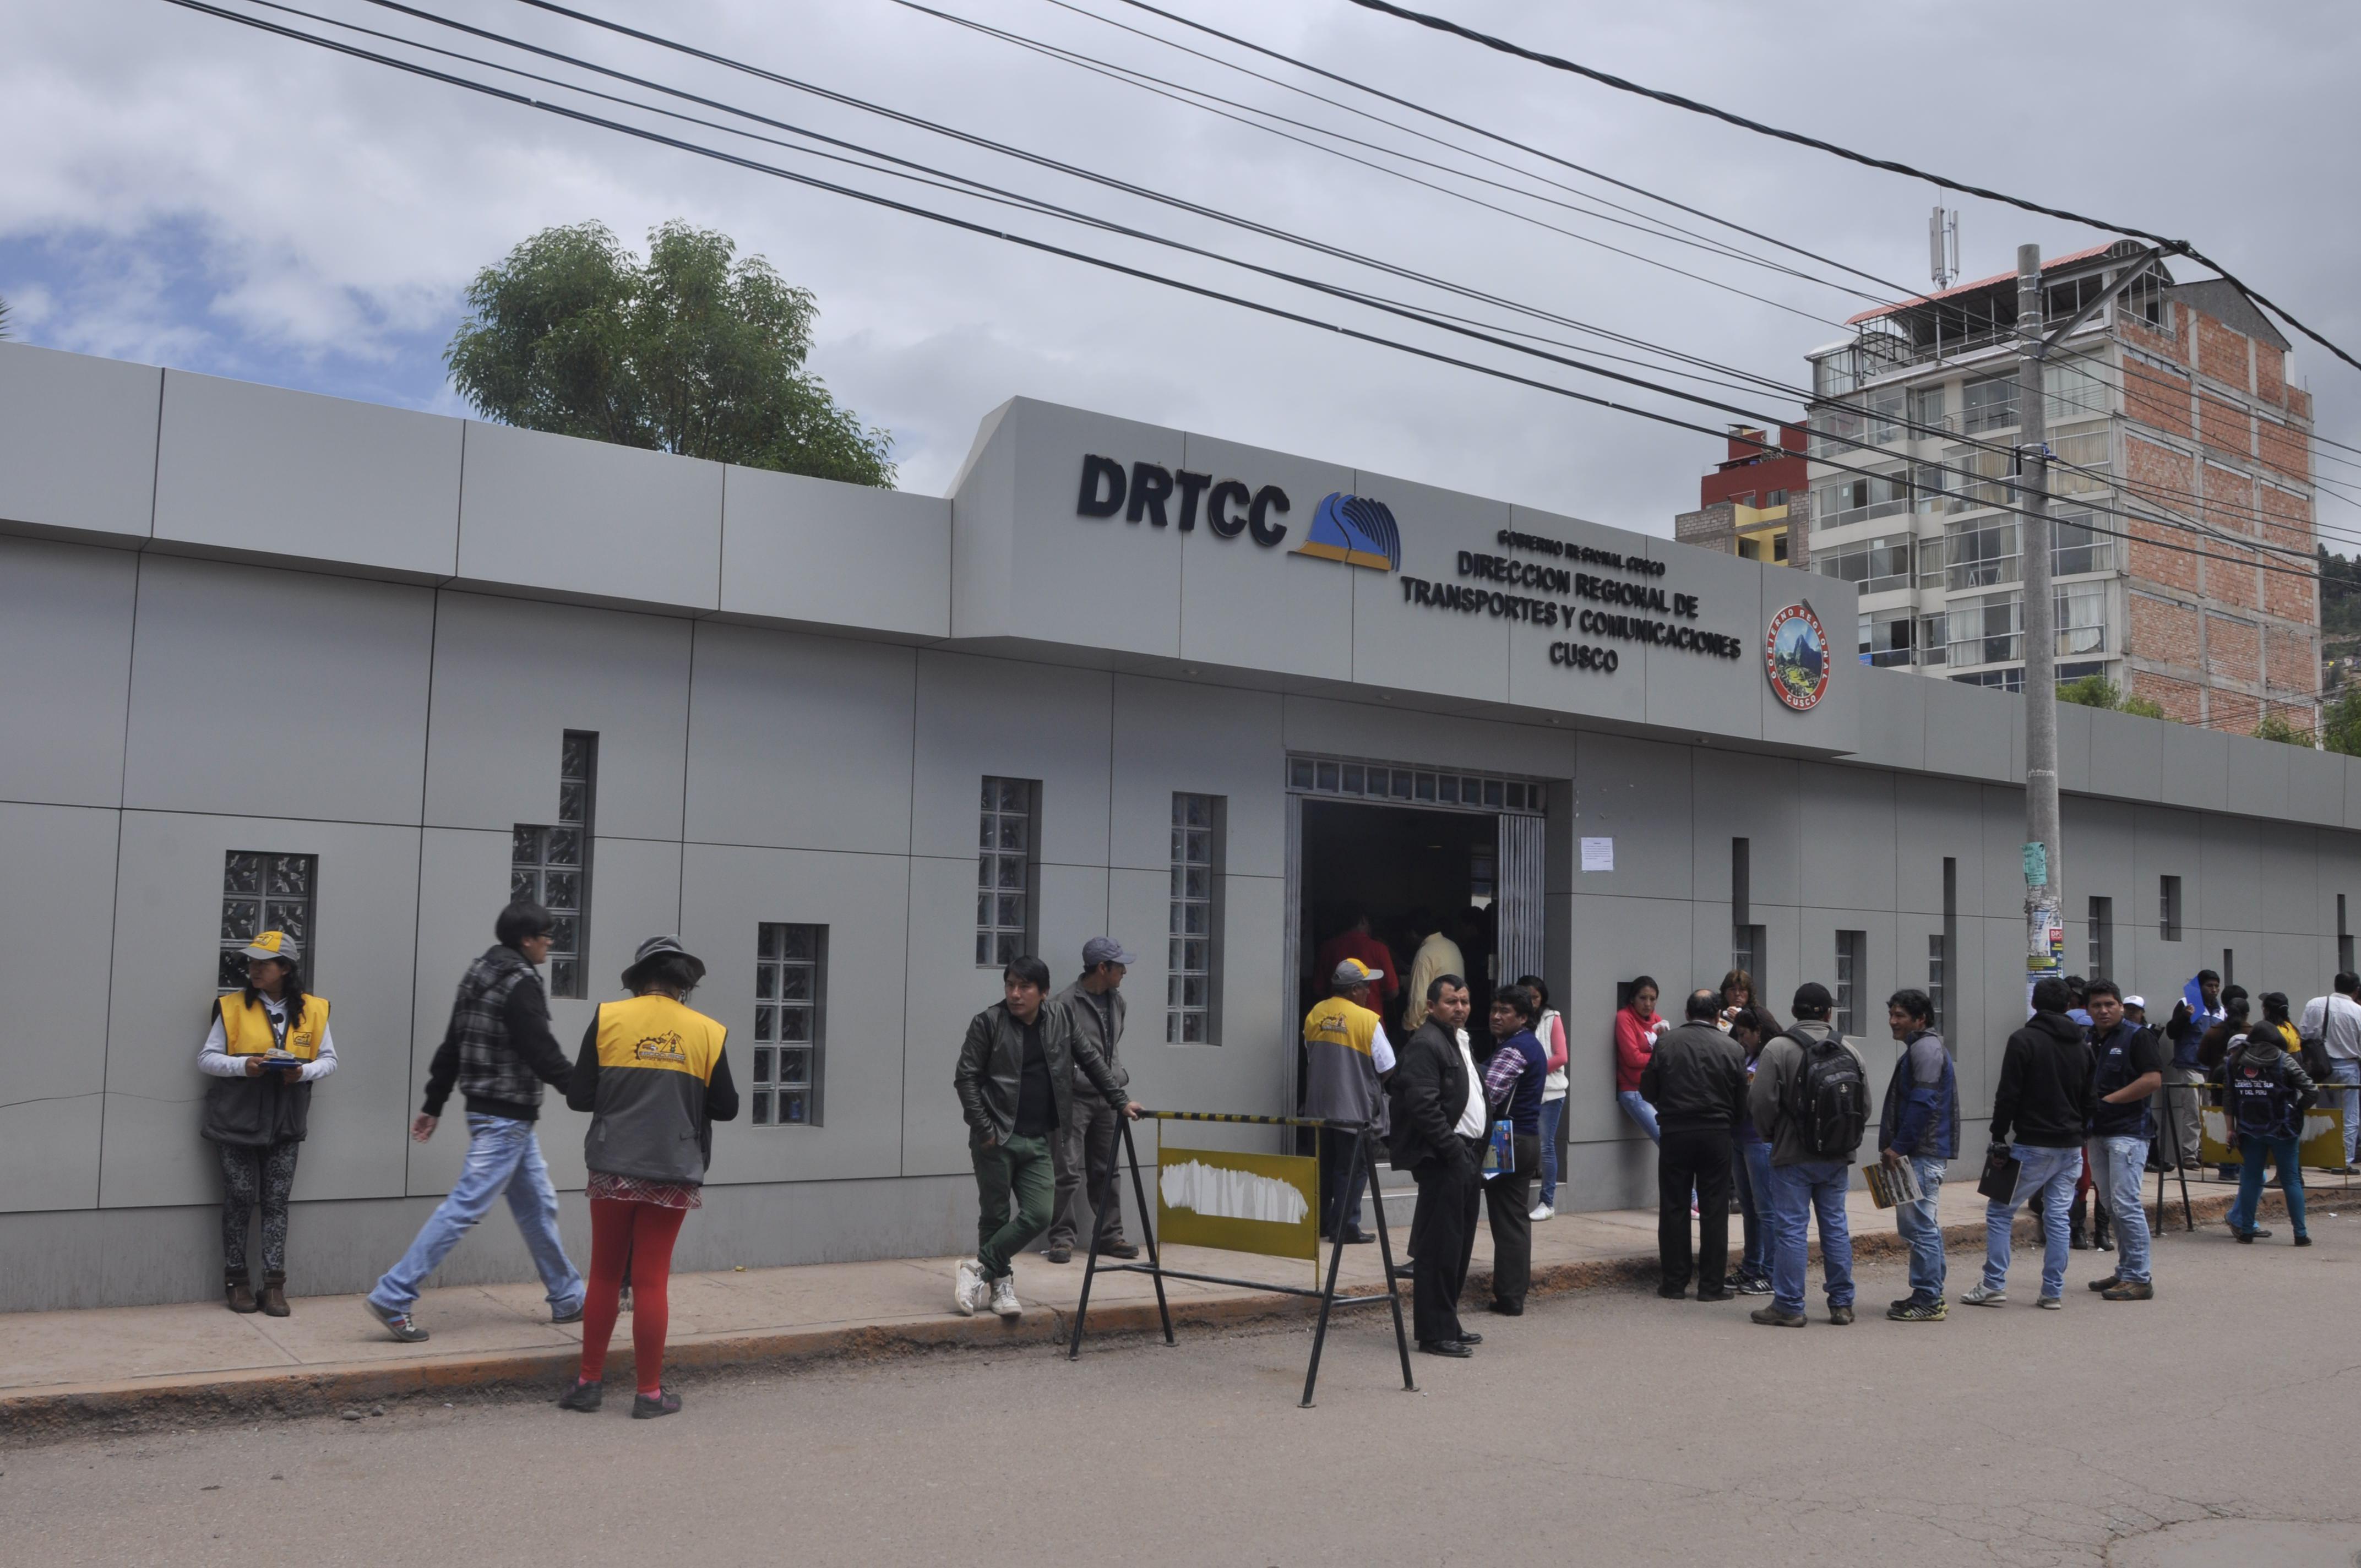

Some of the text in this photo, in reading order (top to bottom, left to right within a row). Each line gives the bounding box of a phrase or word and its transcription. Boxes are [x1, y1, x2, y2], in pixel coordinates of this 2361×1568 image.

[1077, 454, 1290, 547] DRTCC
[1458, 551, 1699, 618] DIRECCION REGIONAL DE
[1497, 529, 1666, 576] GOBIERNO REGIONAL CUSCO
[1401, 575, 1742, 660] TRANSPORTES Y COMUNICACIONES
[1767, 609, 1829, 679] GOBIERNO REGIONAL
[1549, 641, 1619, 673] CUSCO
[1787, 694, 1816, 707] CUSCO
